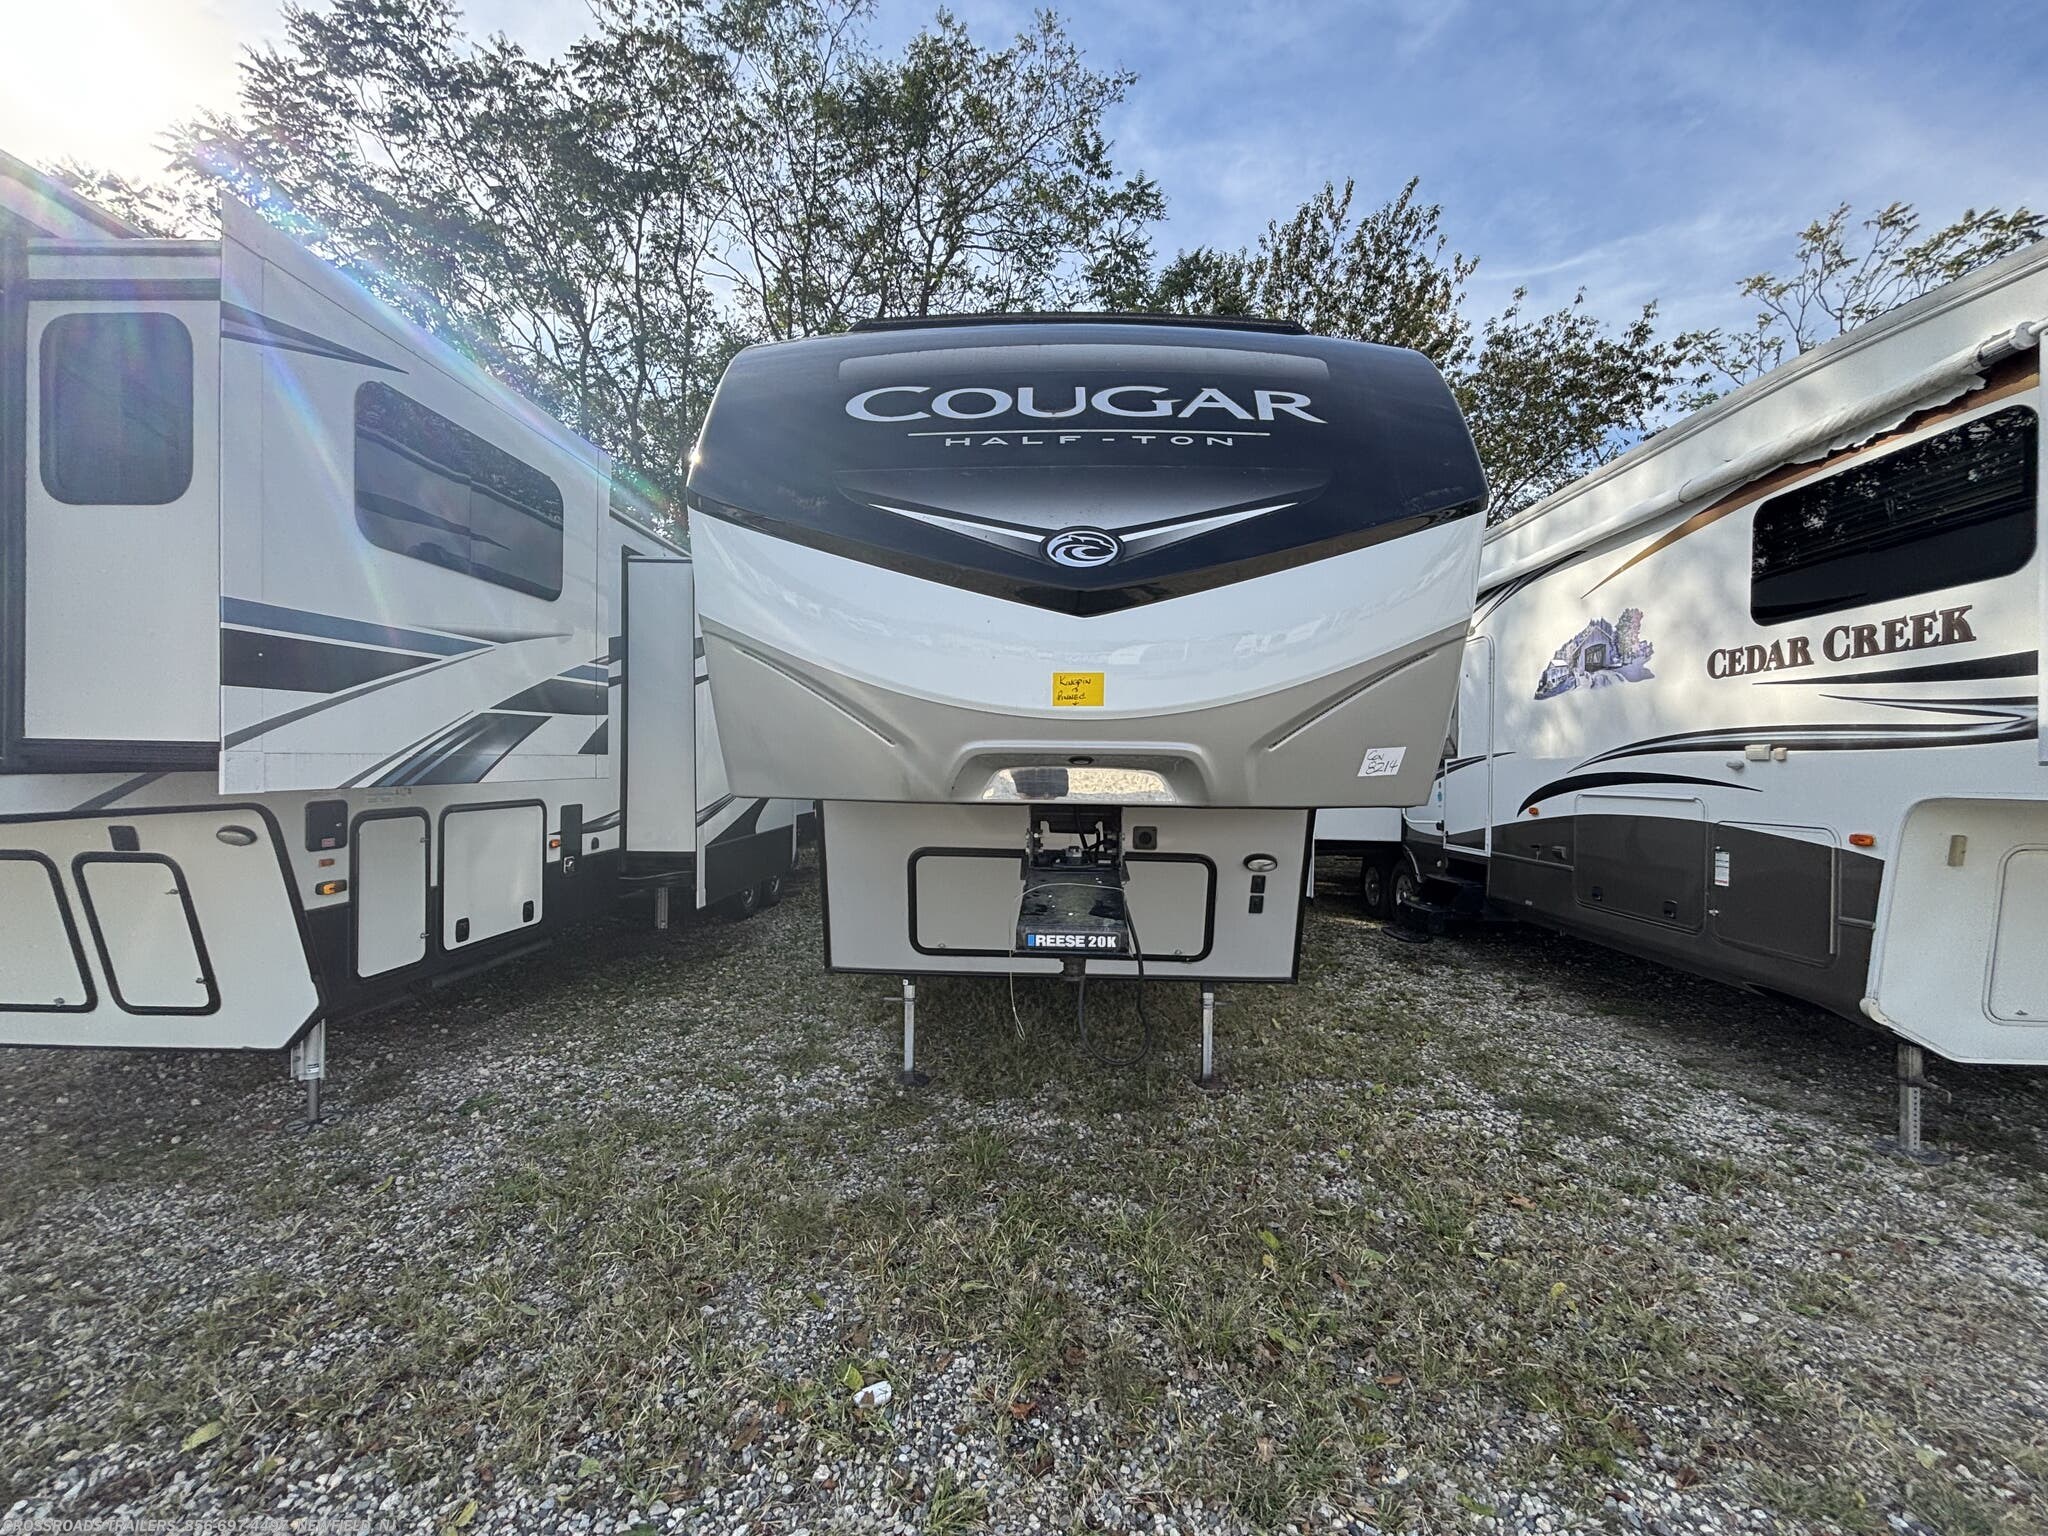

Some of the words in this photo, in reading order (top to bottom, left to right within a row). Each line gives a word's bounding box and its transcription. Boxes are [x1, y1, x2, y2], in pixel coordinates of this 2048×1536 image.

[845, 385, 1328, 424] COUGAR
[1707, 636, 1814, 680] CEDAR
[1822, 604, 1977, 662] CREEK
[1035, 934, 1086, 948] REESE
[1087, 935, 1117, 948] 20K
